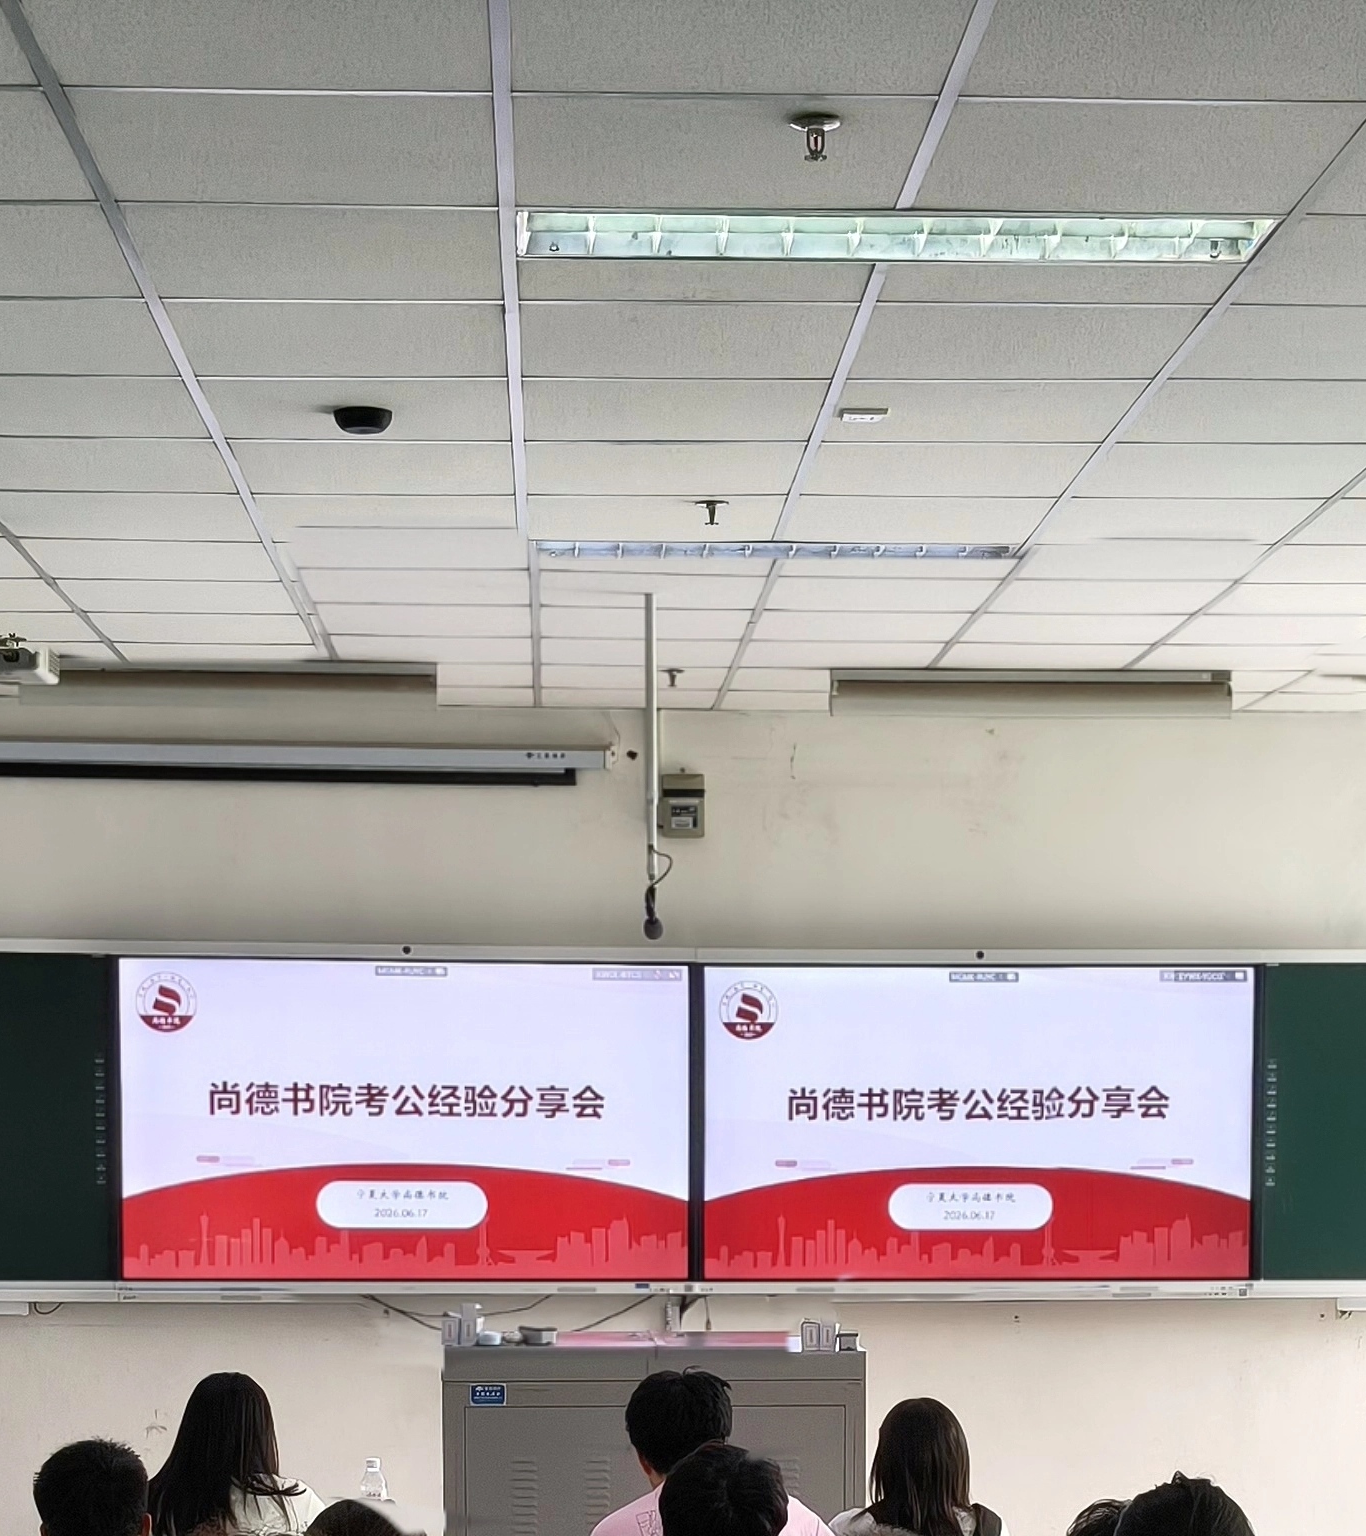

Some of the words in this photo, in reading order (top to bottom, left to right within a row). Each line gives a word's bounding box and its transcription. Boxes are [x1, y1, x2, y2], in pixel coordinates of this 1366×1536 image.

[209, 1081, 605, 1119] 尚德书院考公经验分享会
[788, 1086, 1169, 1121] 尚德书院考公经验分享会
[374, 1208, 428, 1218] 2026.06.17
[943, 1211, 995, 1220] 2026.06.17
